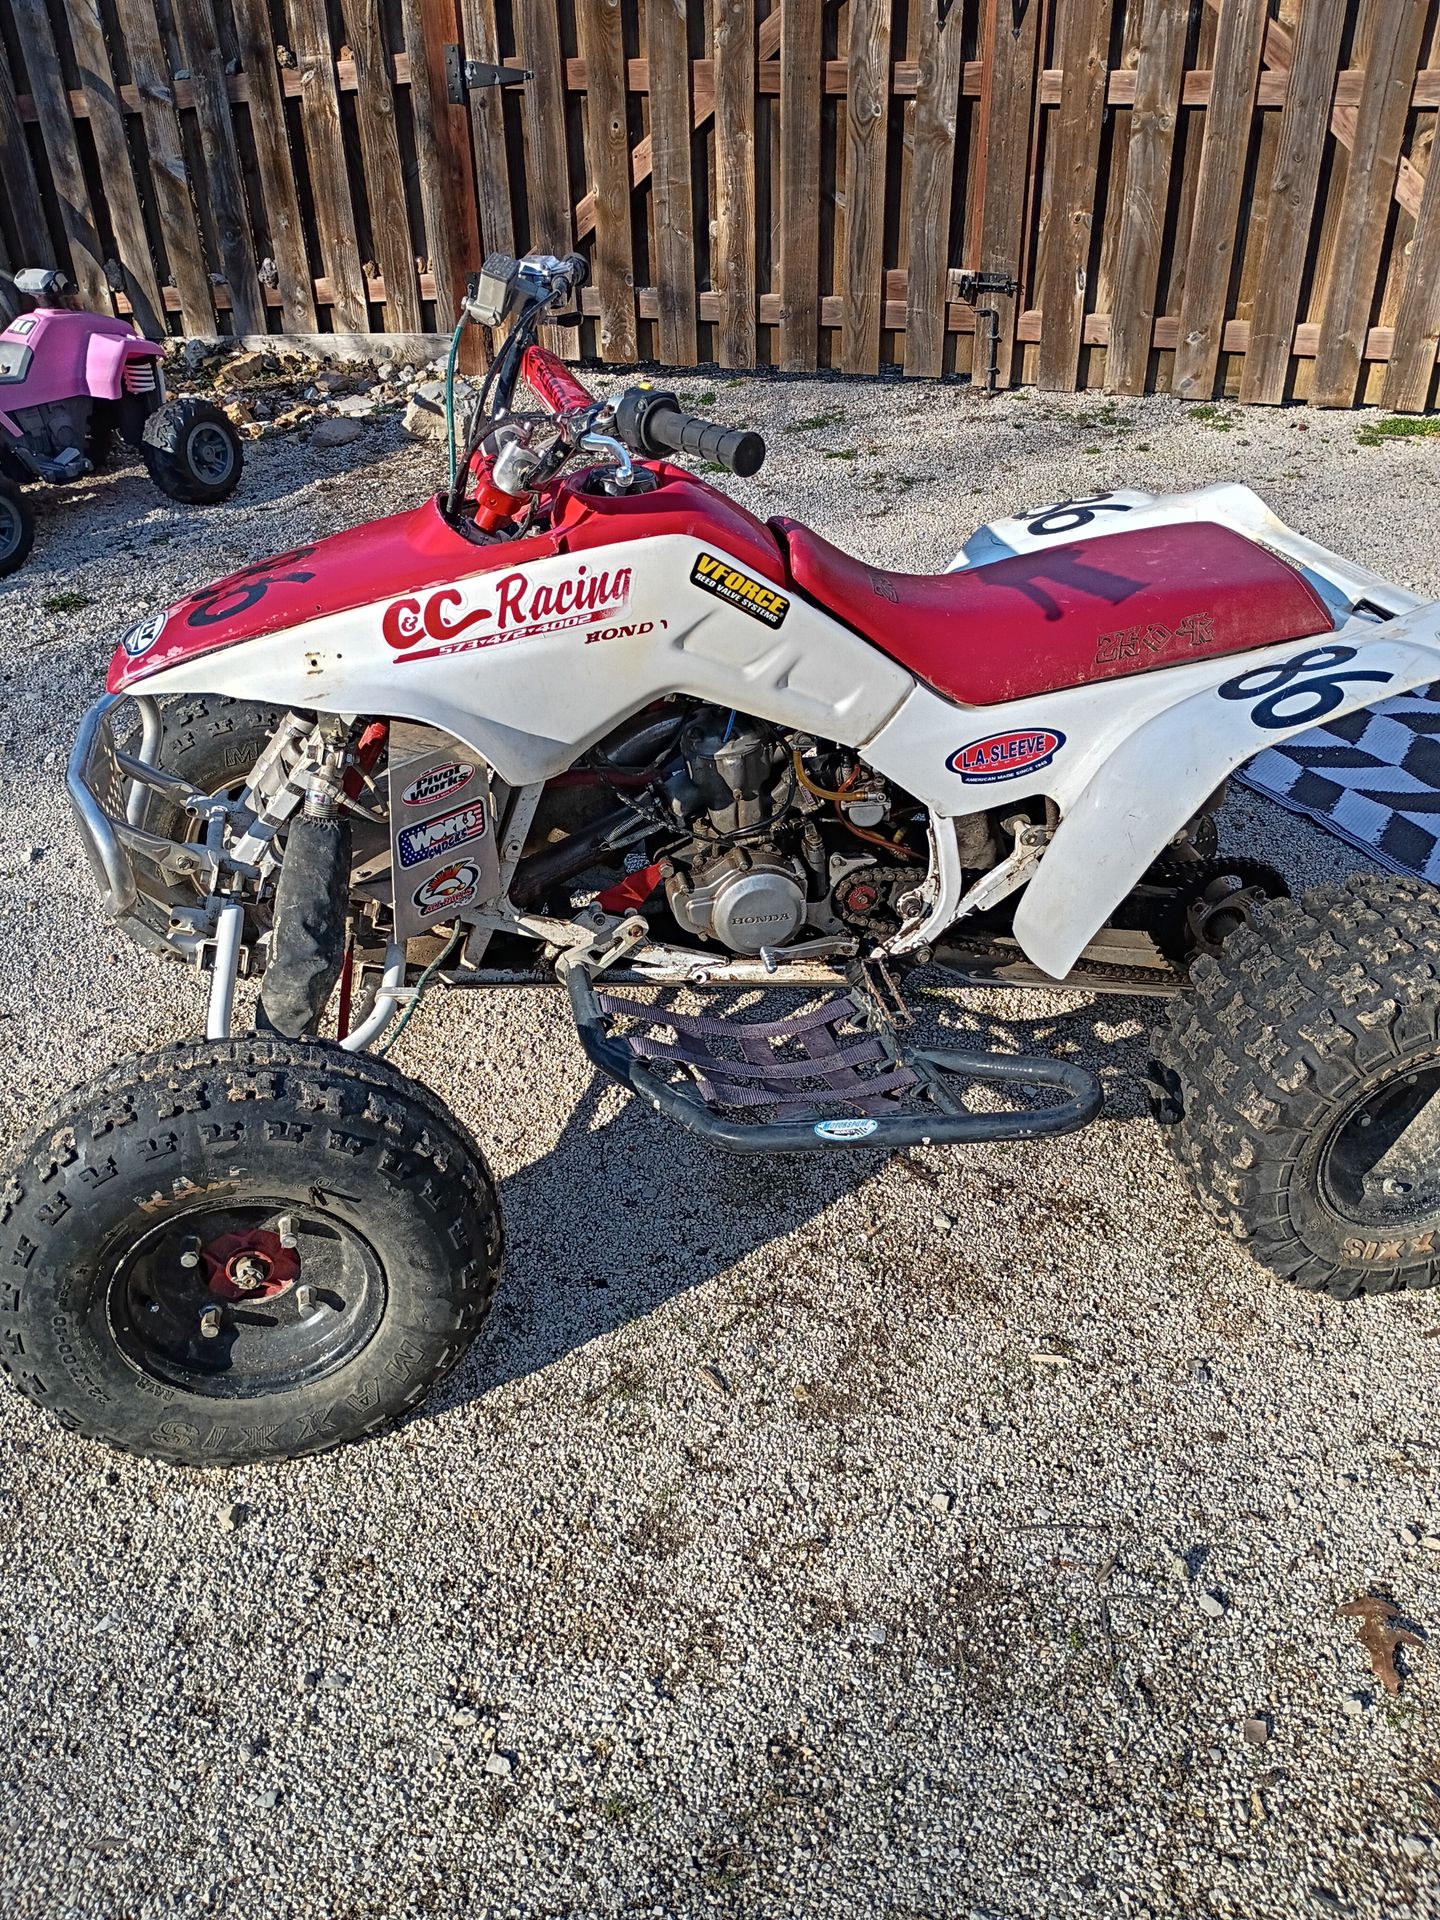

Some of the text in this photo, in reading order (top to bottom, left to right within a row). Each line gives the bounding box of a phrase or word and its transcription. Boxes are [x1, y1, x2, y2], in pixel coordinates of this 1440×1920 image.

[495, 565, 633, 630] Racing
[694, 573, 716, 587] REED
[716, 584, 741, 601] VALVE
[741, 598, 779, 623] SYSTEMS
[697, 555, 787, 614] VFORCE
[584, 619, 668, 644] HOND
[1217, 645, 1395, 730] 86
[991, 734, 1045, 763] SLEEVE
[410, 771, 469, 802] Works
[416, 764, 461, 791] Pivot
[964, 775, 996, 783] AMERICAN
[997, 772, 1015, 780] MADE
[1015, 766, 1034, 776] SINCE
[408, 810, 476, 852] WORKS
[732, 912, 791, 926] HONDA
[1340, 1229, 1440, 1263] XXIS
[151, 1338, 426, 1452] MAXXIS
